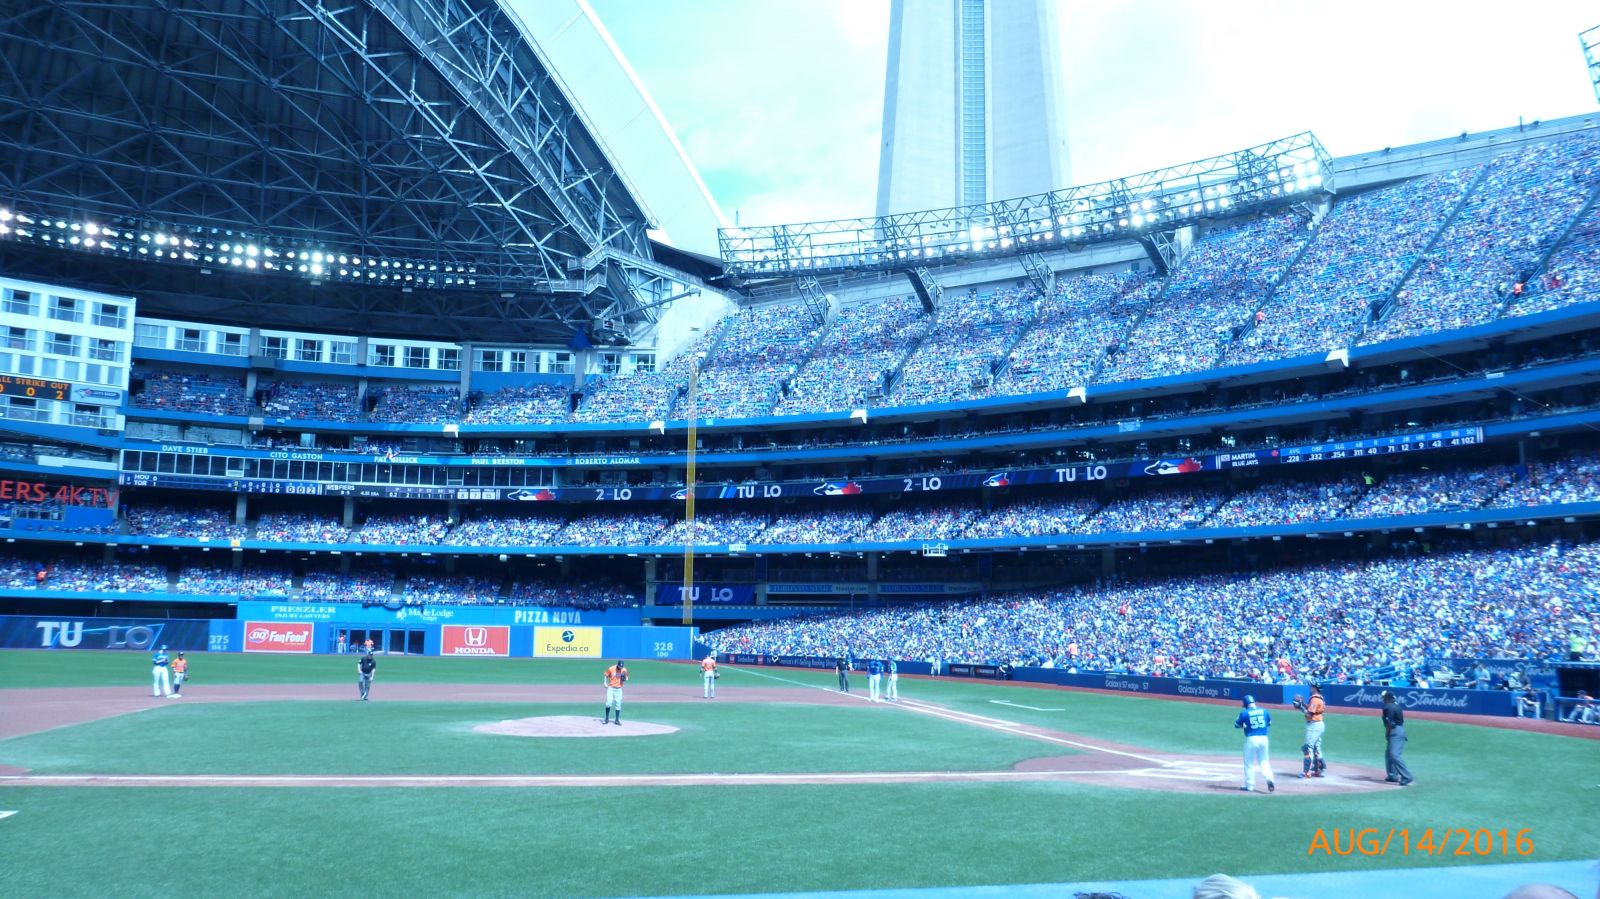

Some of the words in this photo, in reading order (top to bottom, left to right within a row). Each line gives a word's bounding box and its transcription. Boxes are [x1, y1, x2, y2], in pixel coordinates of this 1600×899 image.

[16, 378, 46, 388] STRIKE
[50, 382, 69, 390] OUT
[26, 387, 36, 396] 0
[56, 390, 64, 400] 2
[162, 444, 182, 452] DAVE
[1232, 452, 1256, 461] MARTIN
[1056, 468, 1076, 482] TU
[1086, 466, 1107, 480] LO
[0, 480, 46, 502] ERS
[737, 487, 754, 498] TU
[764, 486, 782, 498] LO
[678, 586, 700, 600] TU
[711, 588, 734, 602] LO
[432, 608, 454, 618] Lodge
[514, 610, 548, 624] PIZZA
[553, 611, 581, 624] NOVA
[36, 622, 84, 648] TU
[106, 626, 152, 648] LO
[209, 635, 229, 644] 375
[546, 644, 589, 653] Expedia.ca
[654, 642, 673, 651] 328
[1178, 685, 1198, 695] Galaxy
[1206, 688, 1218, 697] edge
[1406, 690, 1468, 708] Standard
[1250, 715, 1265, 729] 55
